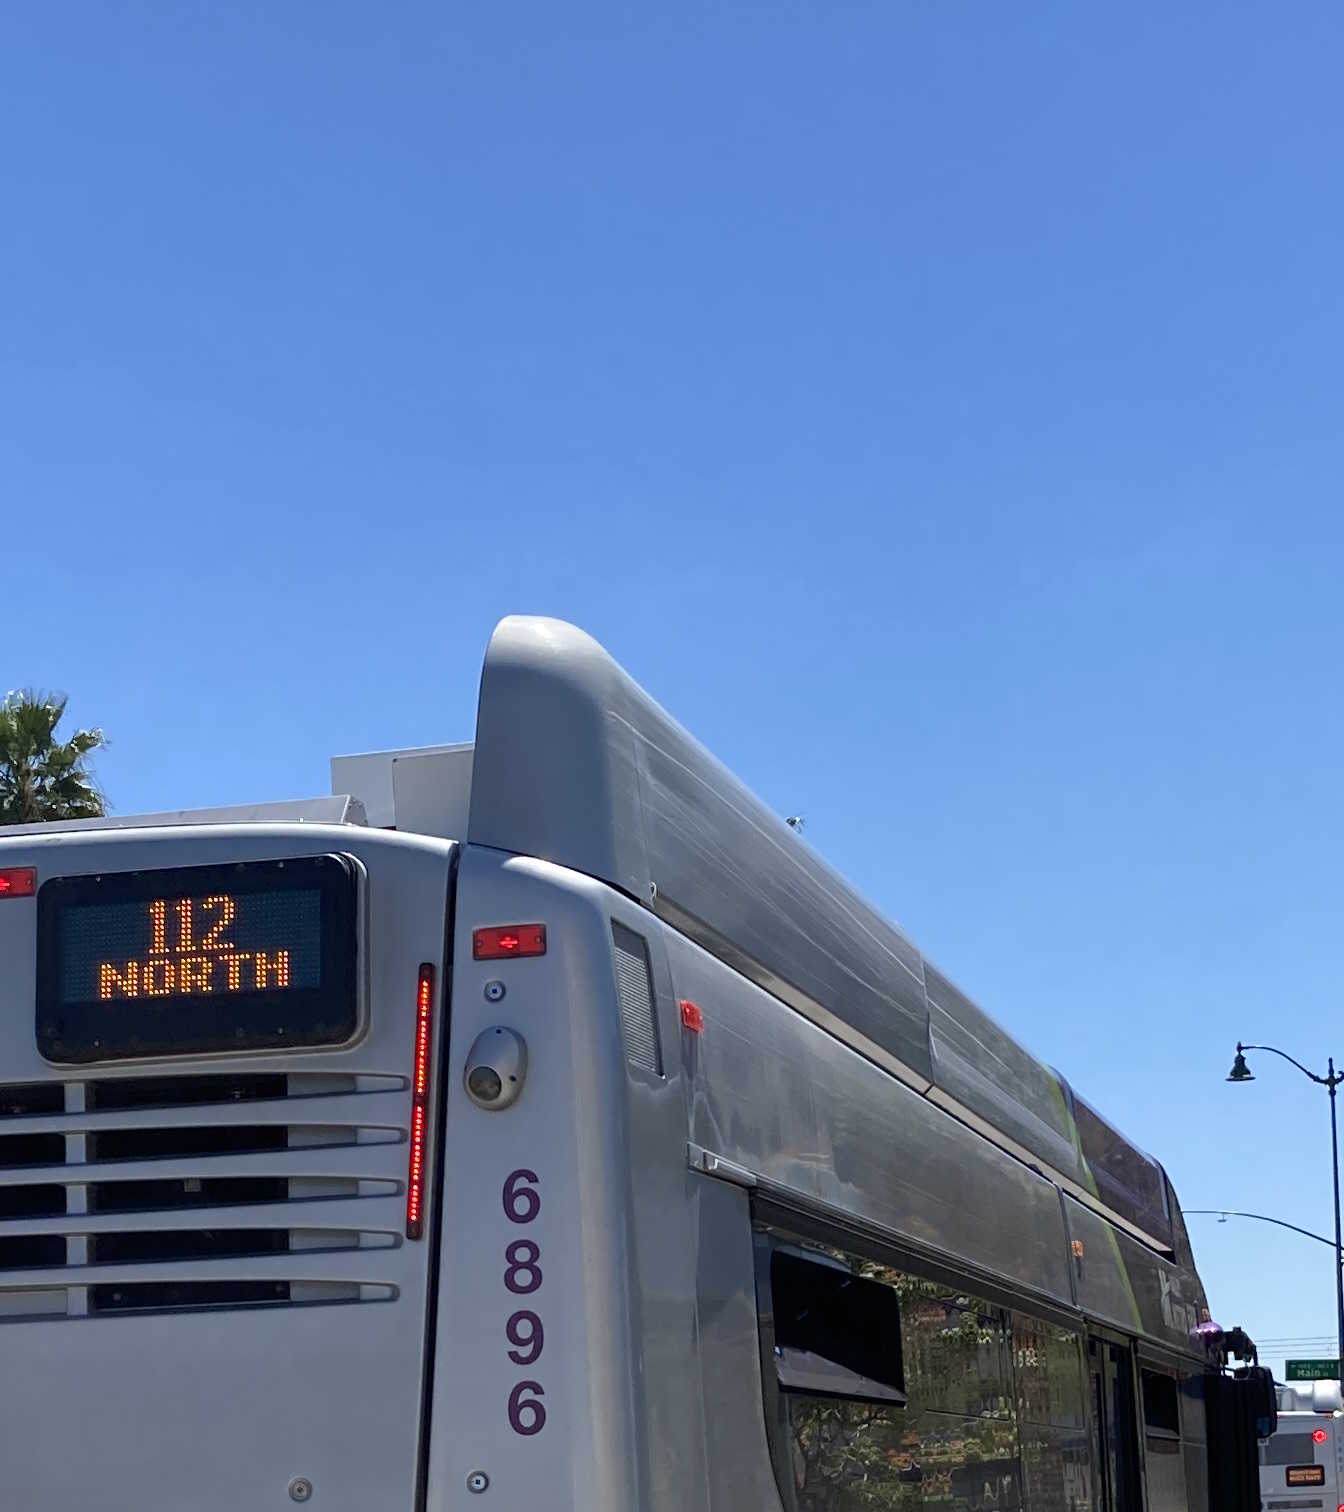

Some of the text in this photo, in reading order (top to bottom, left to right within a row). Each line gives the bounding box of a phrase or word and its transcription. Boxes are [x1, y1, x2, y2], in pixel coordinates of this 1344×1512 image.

[149, 895, 235, 953] 112
[100, 951, 289, 998] NORTH
[502, 1168, 547, 1436] 6896
